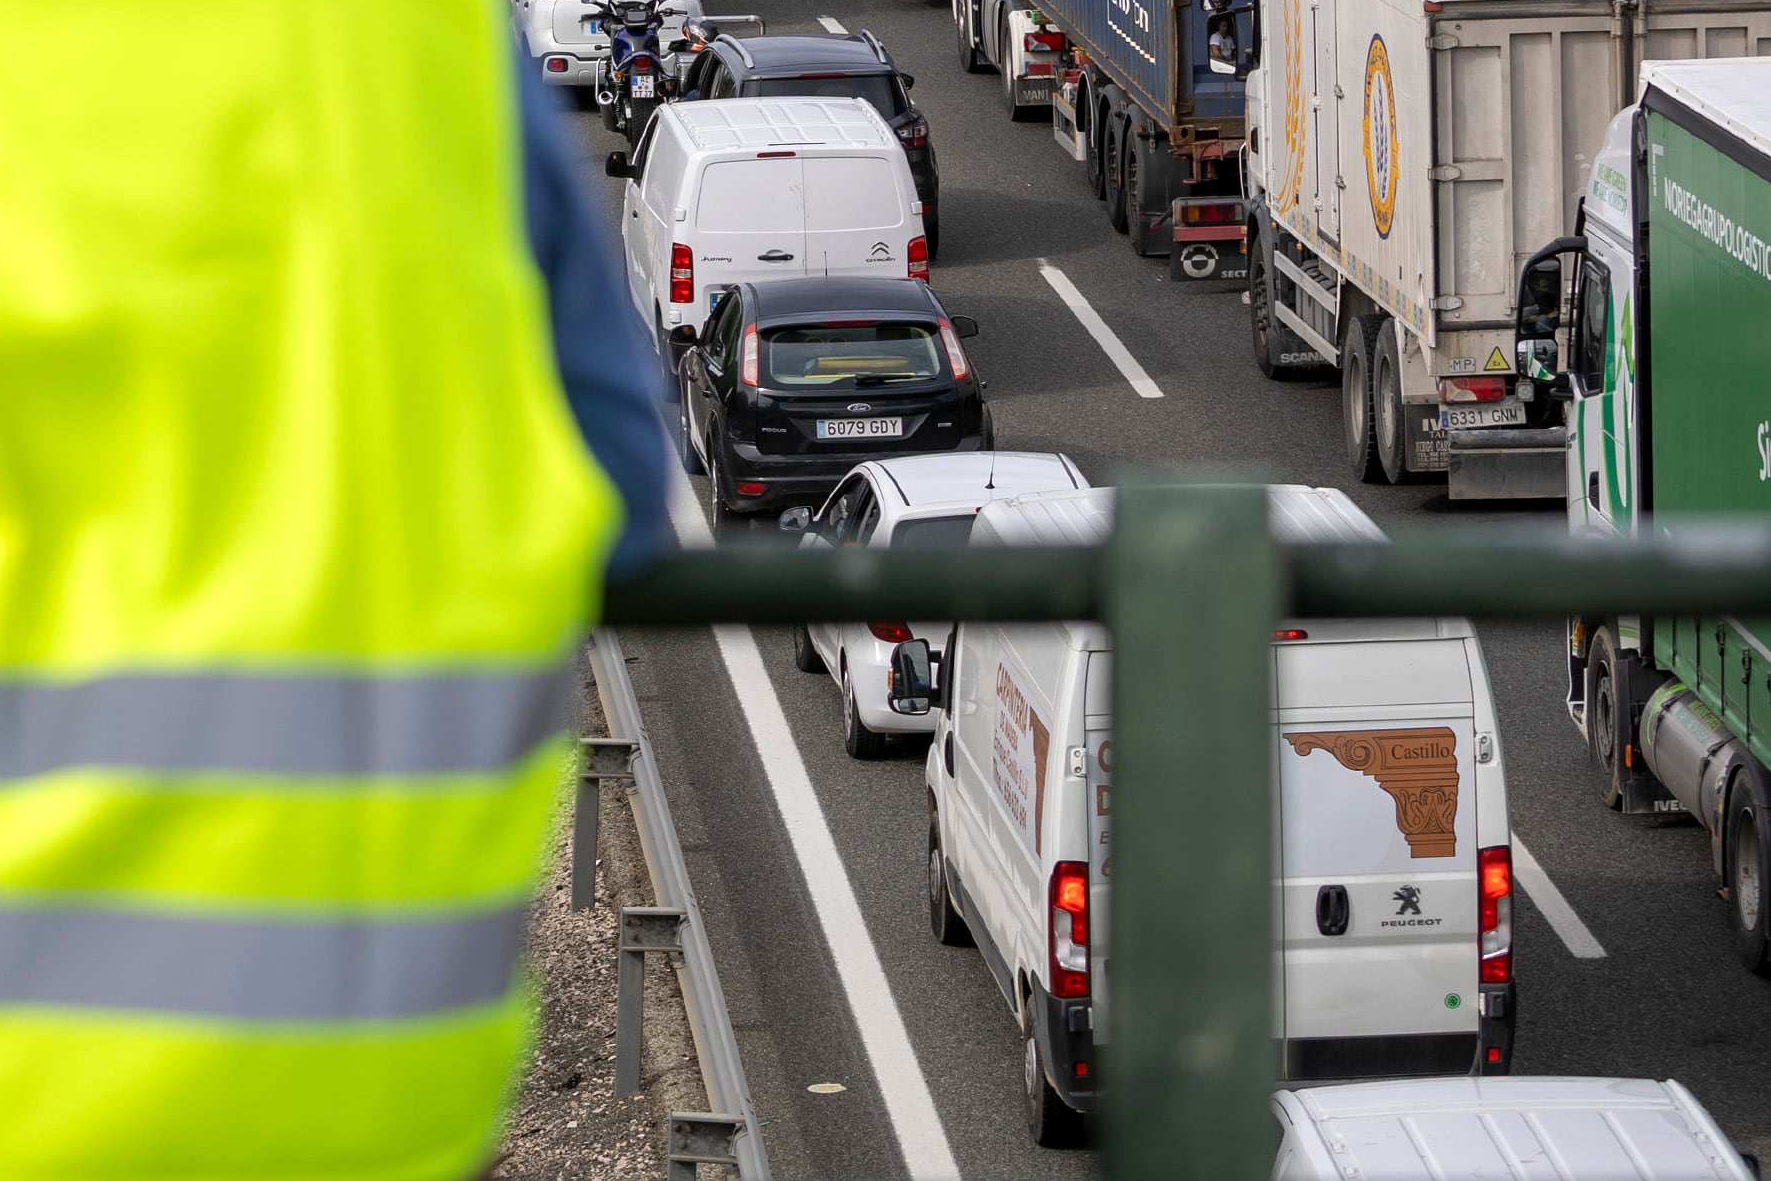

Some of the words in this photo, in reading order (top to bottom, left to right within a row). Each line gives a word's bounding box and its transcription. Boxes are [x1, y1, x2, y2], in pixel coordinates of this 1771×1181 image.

[1450, 411, 1484, 425] 6331
[1491, 409, 1518, 422] GNM
[828, 421, 865, 435] 6079
[870, 419, 898, 433] GDY
[1391, 744, 1450, 761] Castillo
[1381, 919, 1442, 927] PEUGEOT
